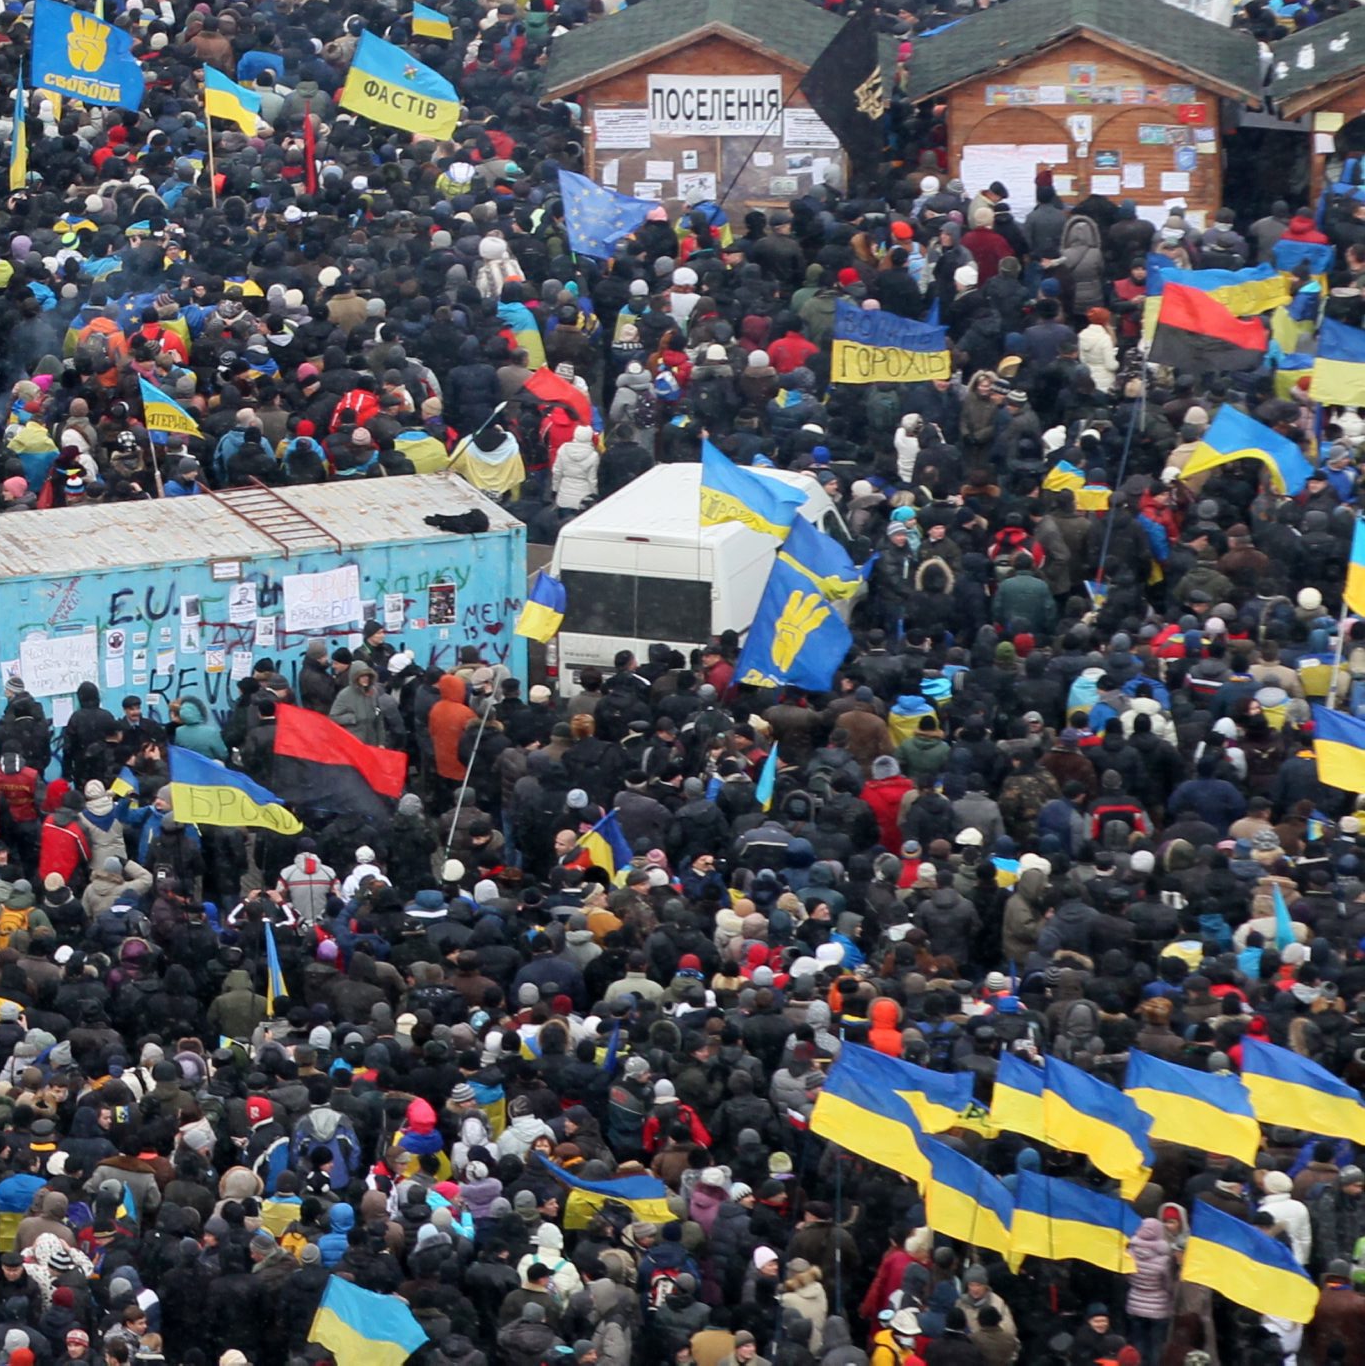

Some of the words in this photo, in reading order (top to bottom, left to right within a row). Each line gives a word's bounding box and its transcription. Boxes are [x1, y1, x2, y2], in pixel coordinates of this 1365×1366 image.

[44, 72, 122, 104] СВОБОДА
[363, 80, 438, 121] ФАСТІВ
[652, 87, 780, 122] ПОСЕЛЕННЯ
[841, 344, 947, 380] ГОРОХІВ
